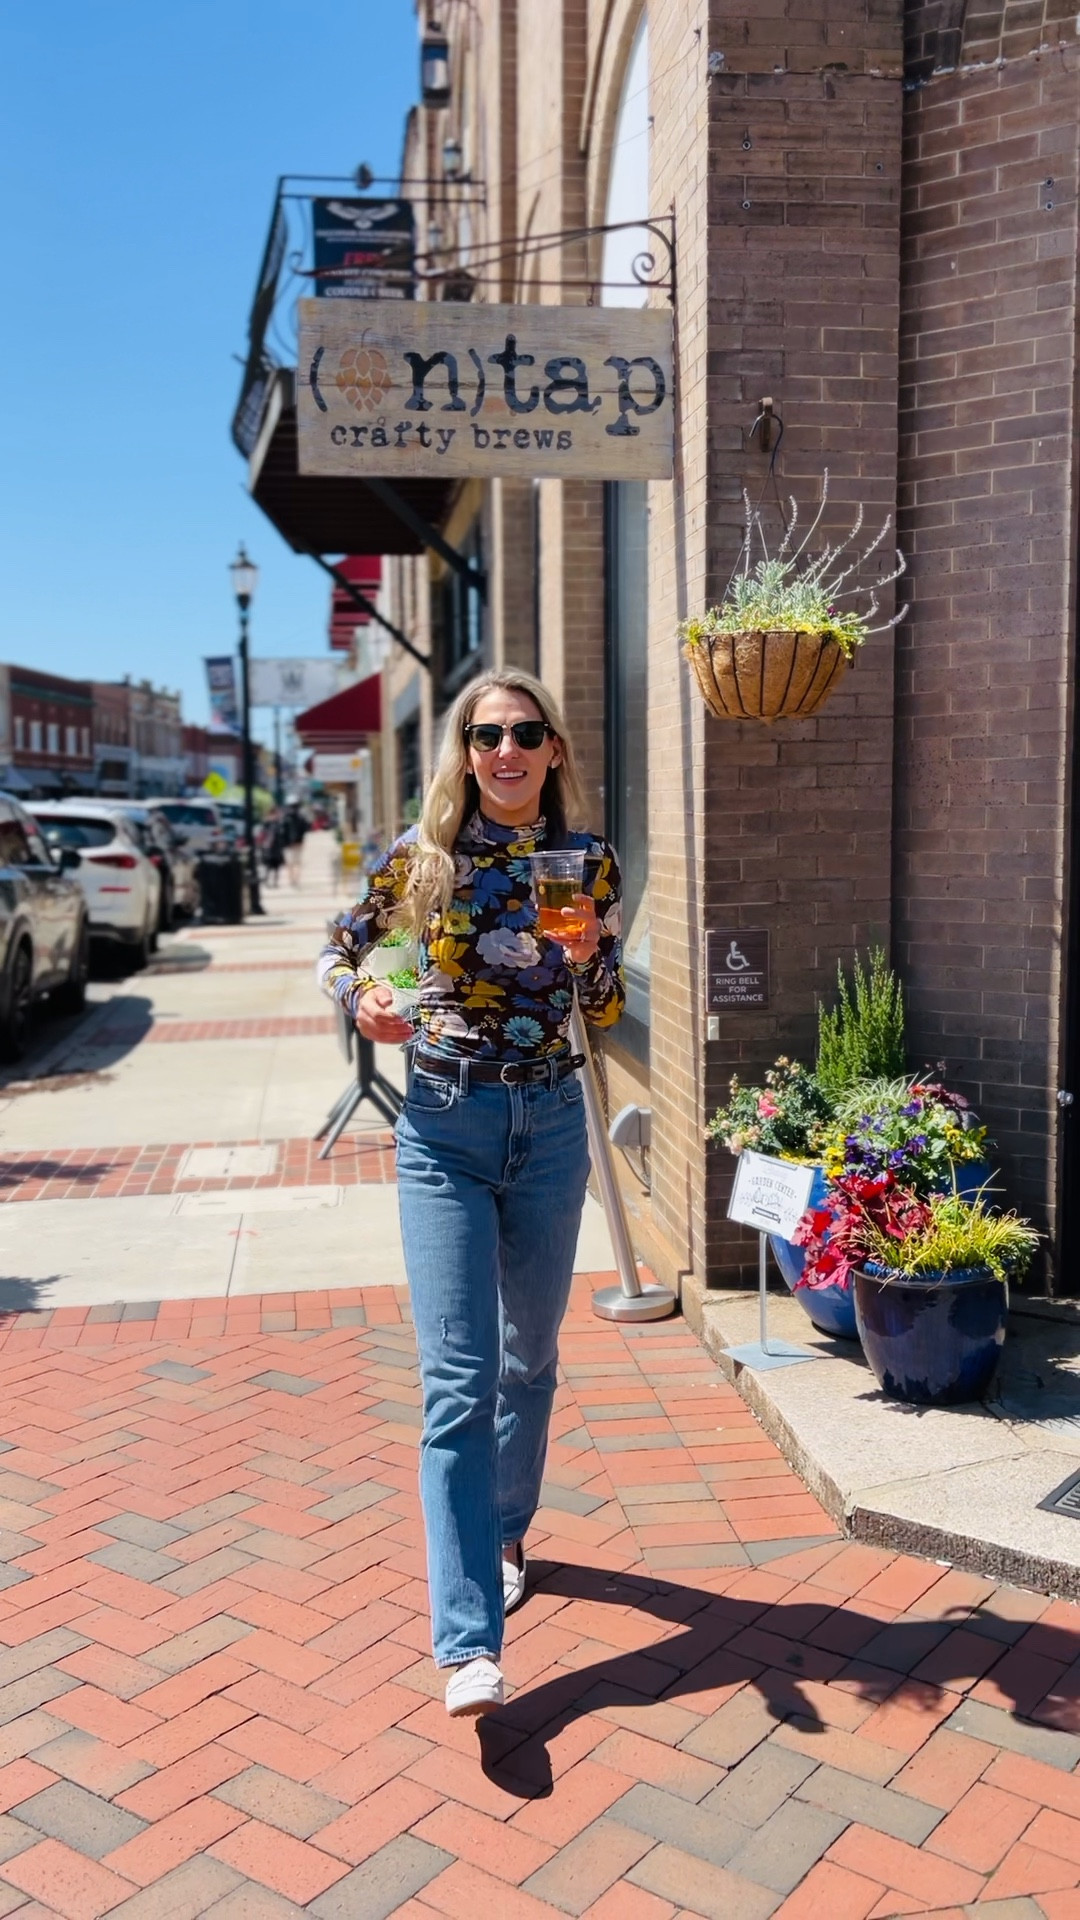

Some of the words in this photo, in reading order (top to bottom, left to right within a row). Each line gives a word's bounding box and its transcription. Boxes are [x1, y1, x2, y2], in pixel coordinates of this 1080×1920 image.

[331, 420, 456, 454] crafty
[471, 423, 572, 450] brews
[712, 994, 764, 1003] ASSISTANCE
[774, 1181, 794, 1198] CENTER
